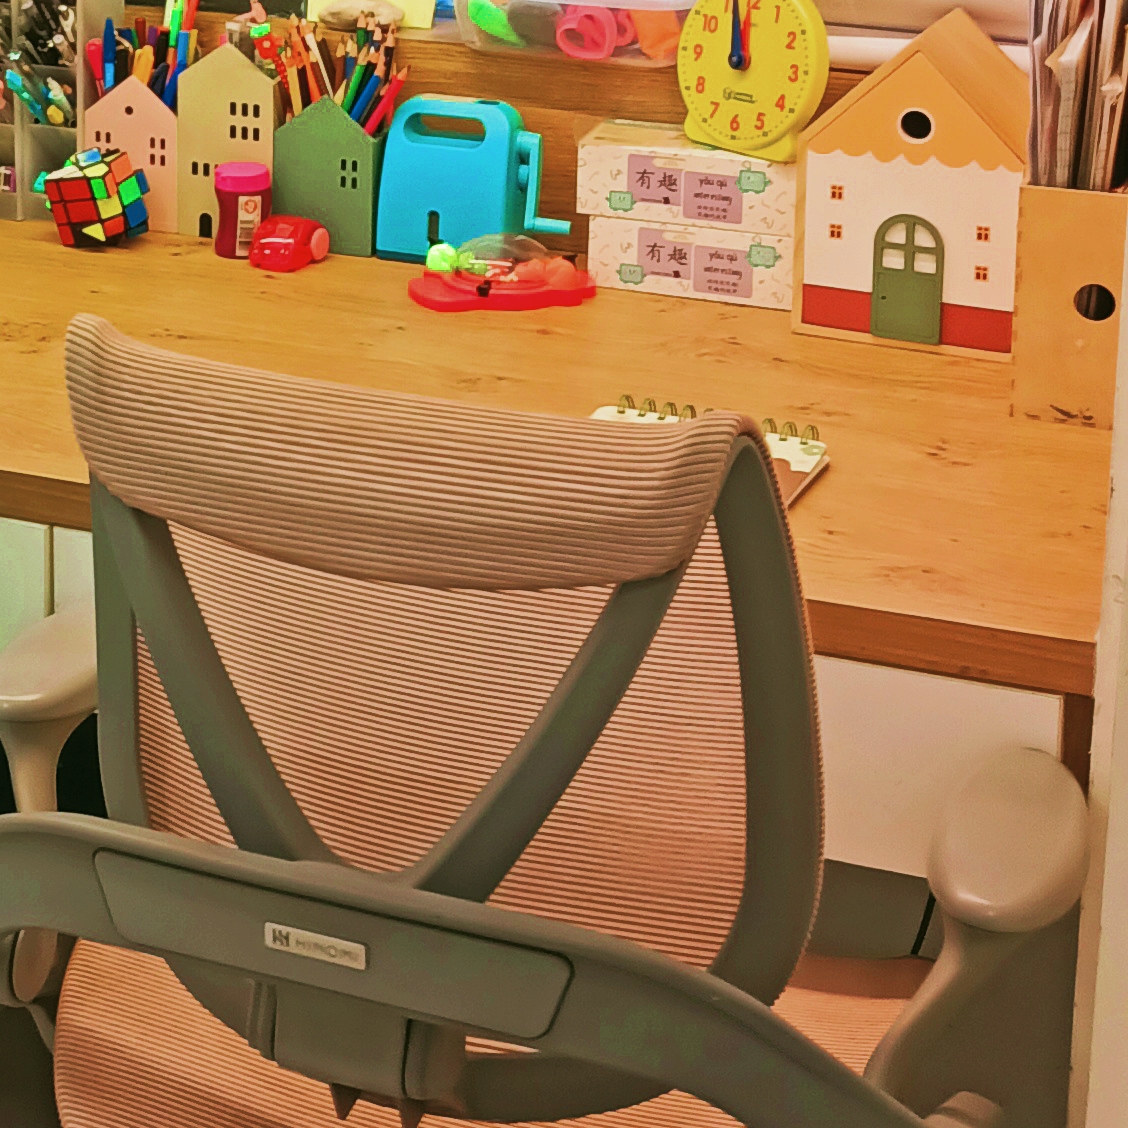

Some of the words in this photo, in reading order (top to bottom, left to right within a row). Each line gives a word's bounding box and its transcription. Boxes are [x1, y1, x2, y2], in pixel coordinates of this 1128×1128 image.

[775, 5, 780, 23] 1
[703, 14, 718, 33] 10
[786, 32, 796, 49] 2
[694, 44, 703, 61] 9
[788, 64, 799, 82] 3
[696, 76, 705, 93] 8
[710, 101, 720, 118] 7
[775, 94, 785, 112] 4
[730, 114, 740, 131] 6
[754, 112, 766, 130] 5
[635, 169, 677, 192] 有趣
[646, 243, 688, 265] 有趣
